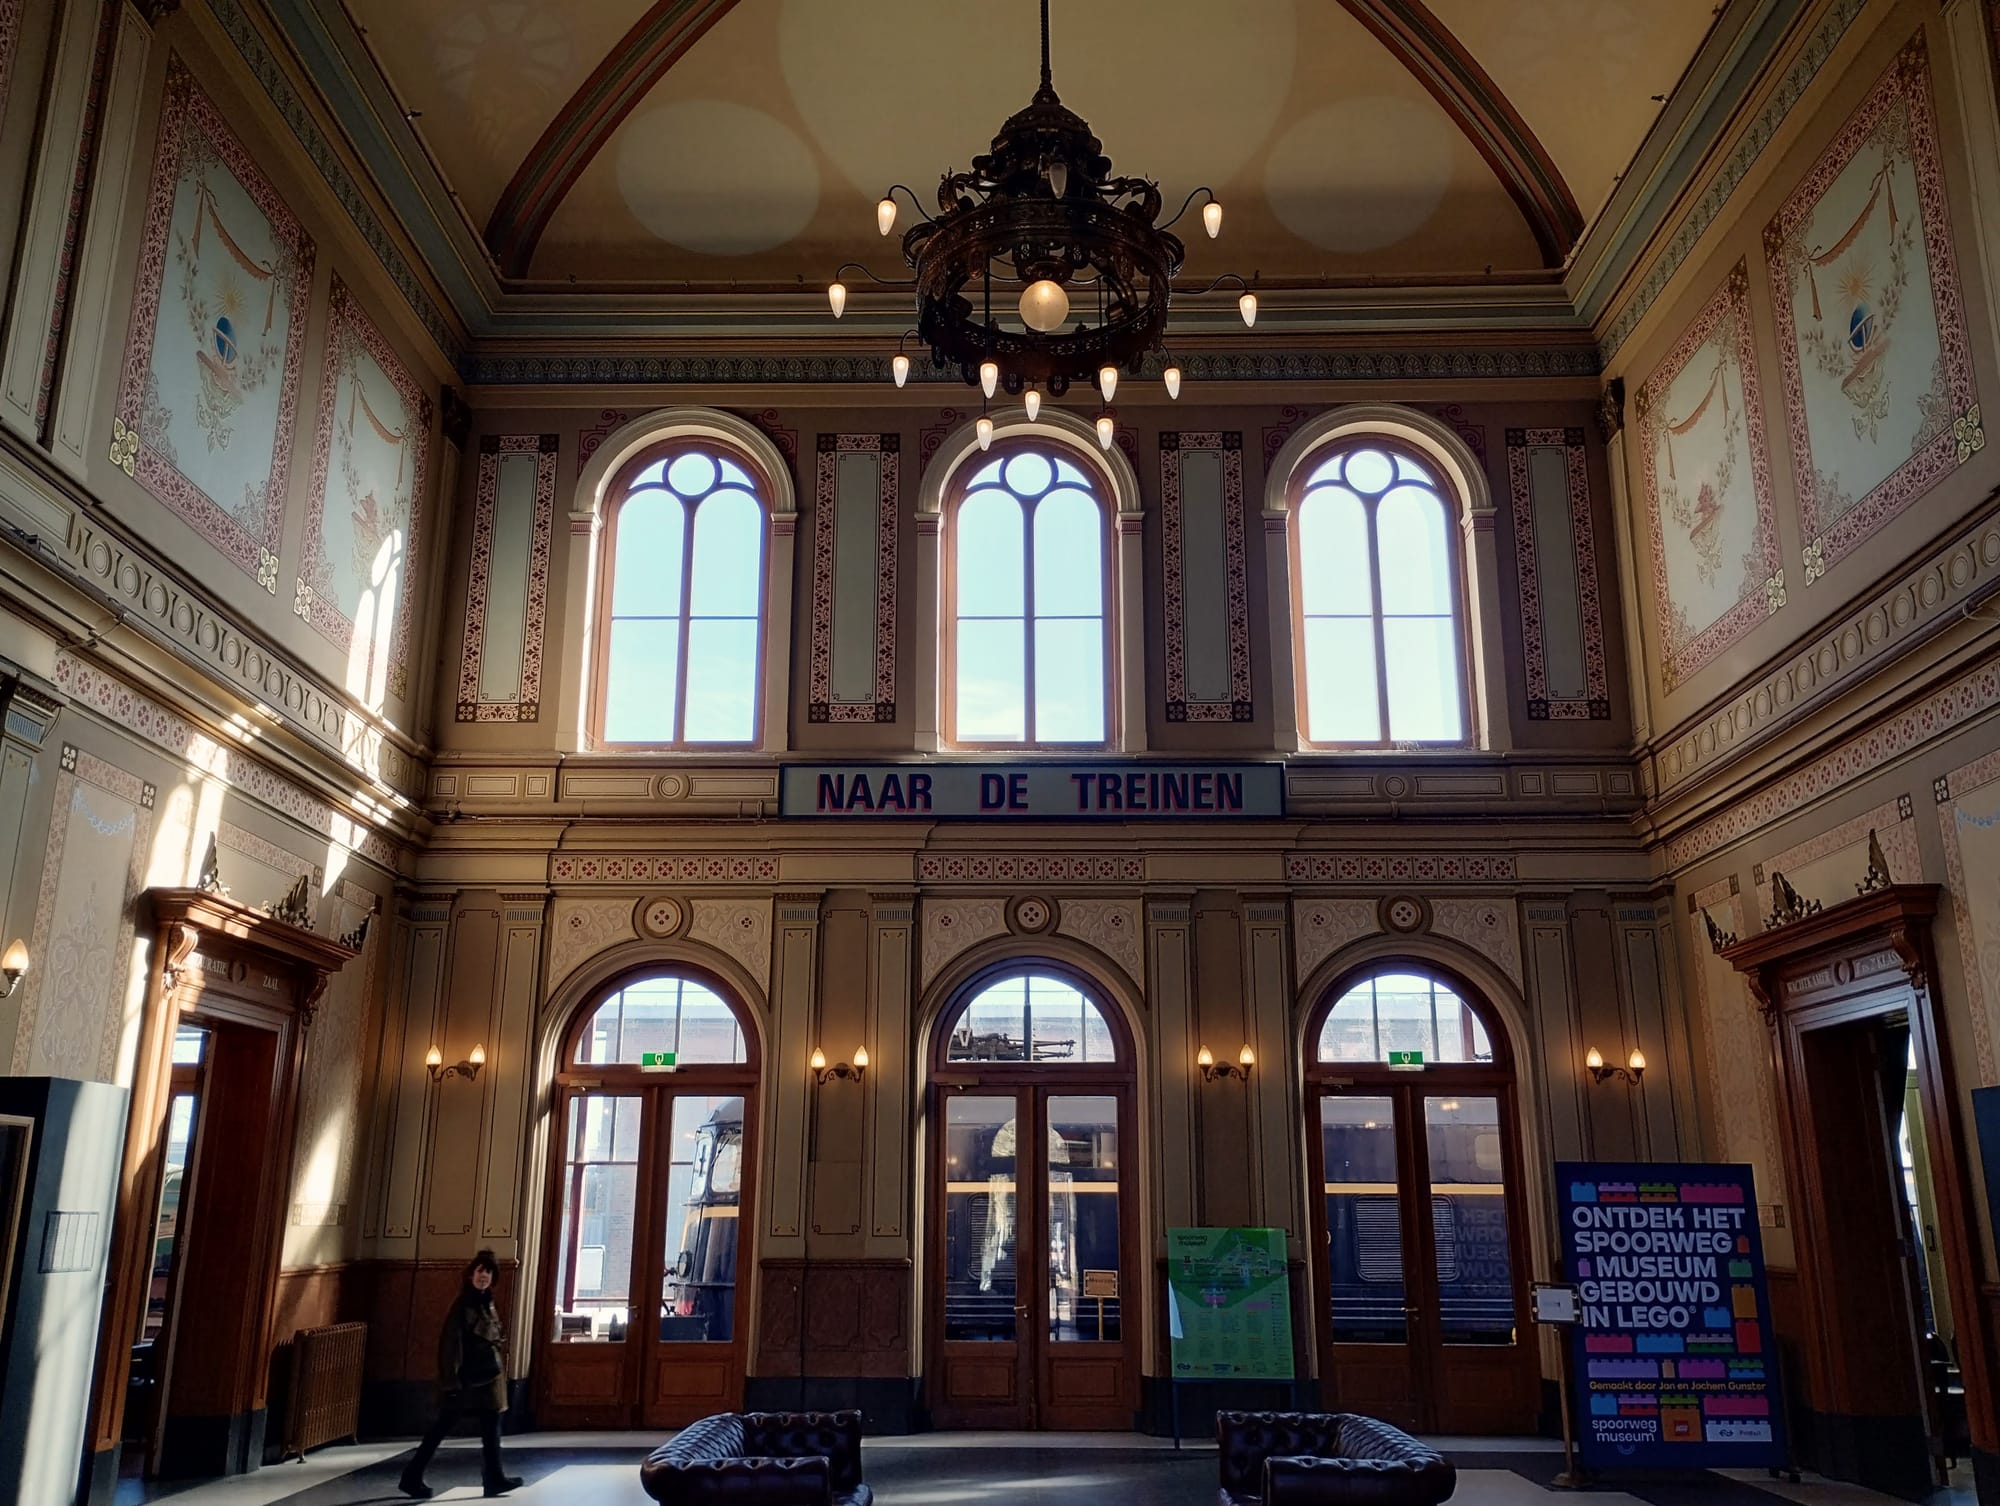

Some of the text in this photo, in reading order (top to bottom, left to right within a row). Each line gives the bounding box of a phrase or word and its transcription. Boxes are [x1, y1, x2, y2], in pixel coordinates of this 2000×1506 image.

[817, 773, 1243, 812] NAAR DE TREINEN
[1572, 1206, 1746, 1229] ONTDEK HET
[1574, 1231, 1733, 1253] SPOORWEG
[1596, 1256, 1718, 1278] MUSEUM
[1579, 1281, 1720, 1303] GEBOUWD
[1582, 1306, 1611, 1328] IN
[1635, 1381, 1657, 1391] door
[1659, 1381, 1675, 1391] Jan
[1676, 1382, 1689, 1390] en
[1592, 1419, 1657, 1433] spoorweg
[1597, 1429, 1655, 1442] museum
